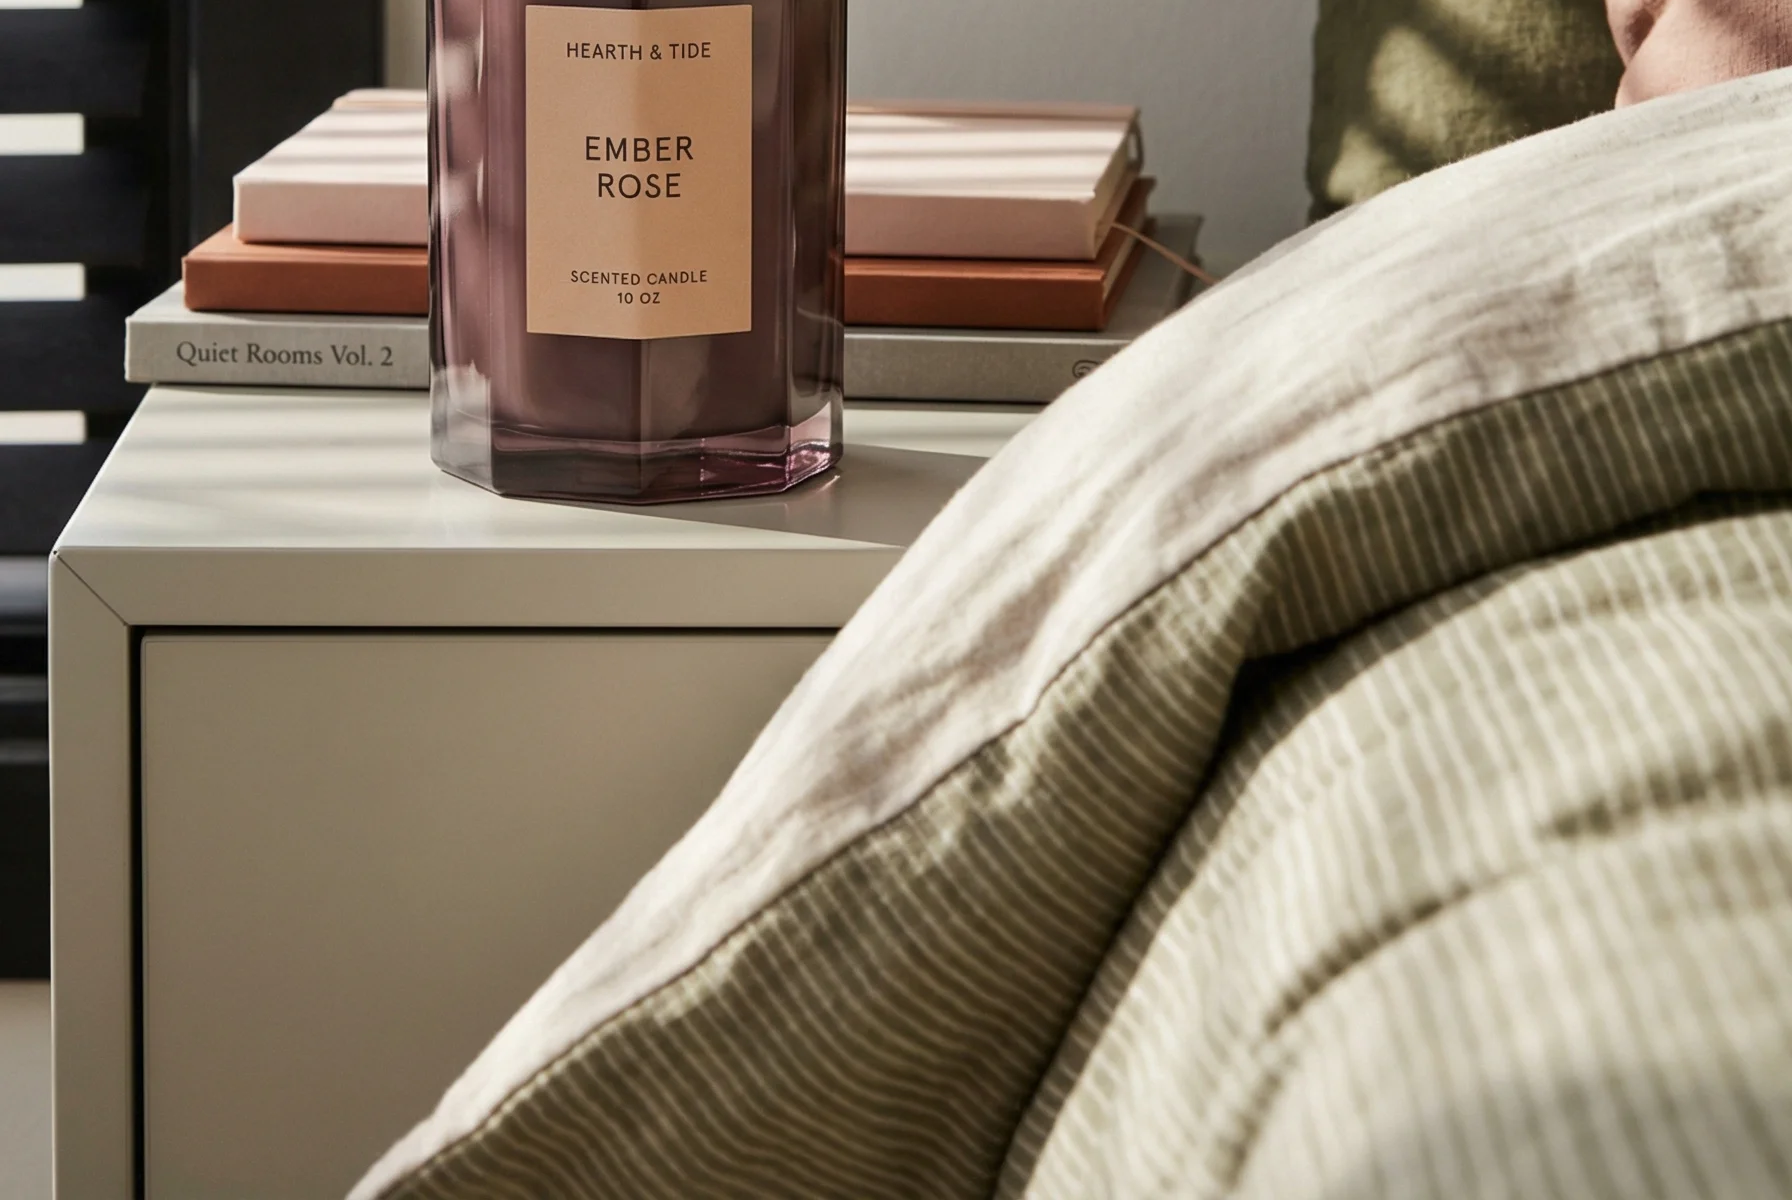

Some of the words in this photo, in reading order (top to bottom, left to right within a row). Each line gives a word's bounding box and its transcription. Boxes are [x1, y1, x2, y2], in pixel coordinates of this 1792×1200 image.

[566, 42, 643, 61] HEARTH
[649, 44, 663, 61] &
[669, 41, 711, 59] TIDE
[585, 136, 694, 162] EMBER
[598, 173, 681, 199] ROSE
[570, 270, 641, 286] SCENTED
[646, 270, 708, 286] CANDLE
[617, 292, 634, 305] 10
[639, 291, 661, 305] OZ
[176, 341, 239, 367] Quiet
[246, 342, 323, 365] Rooms
[330, 345, 373, 367] Vol.
[380, 346, 394, 367] 2
